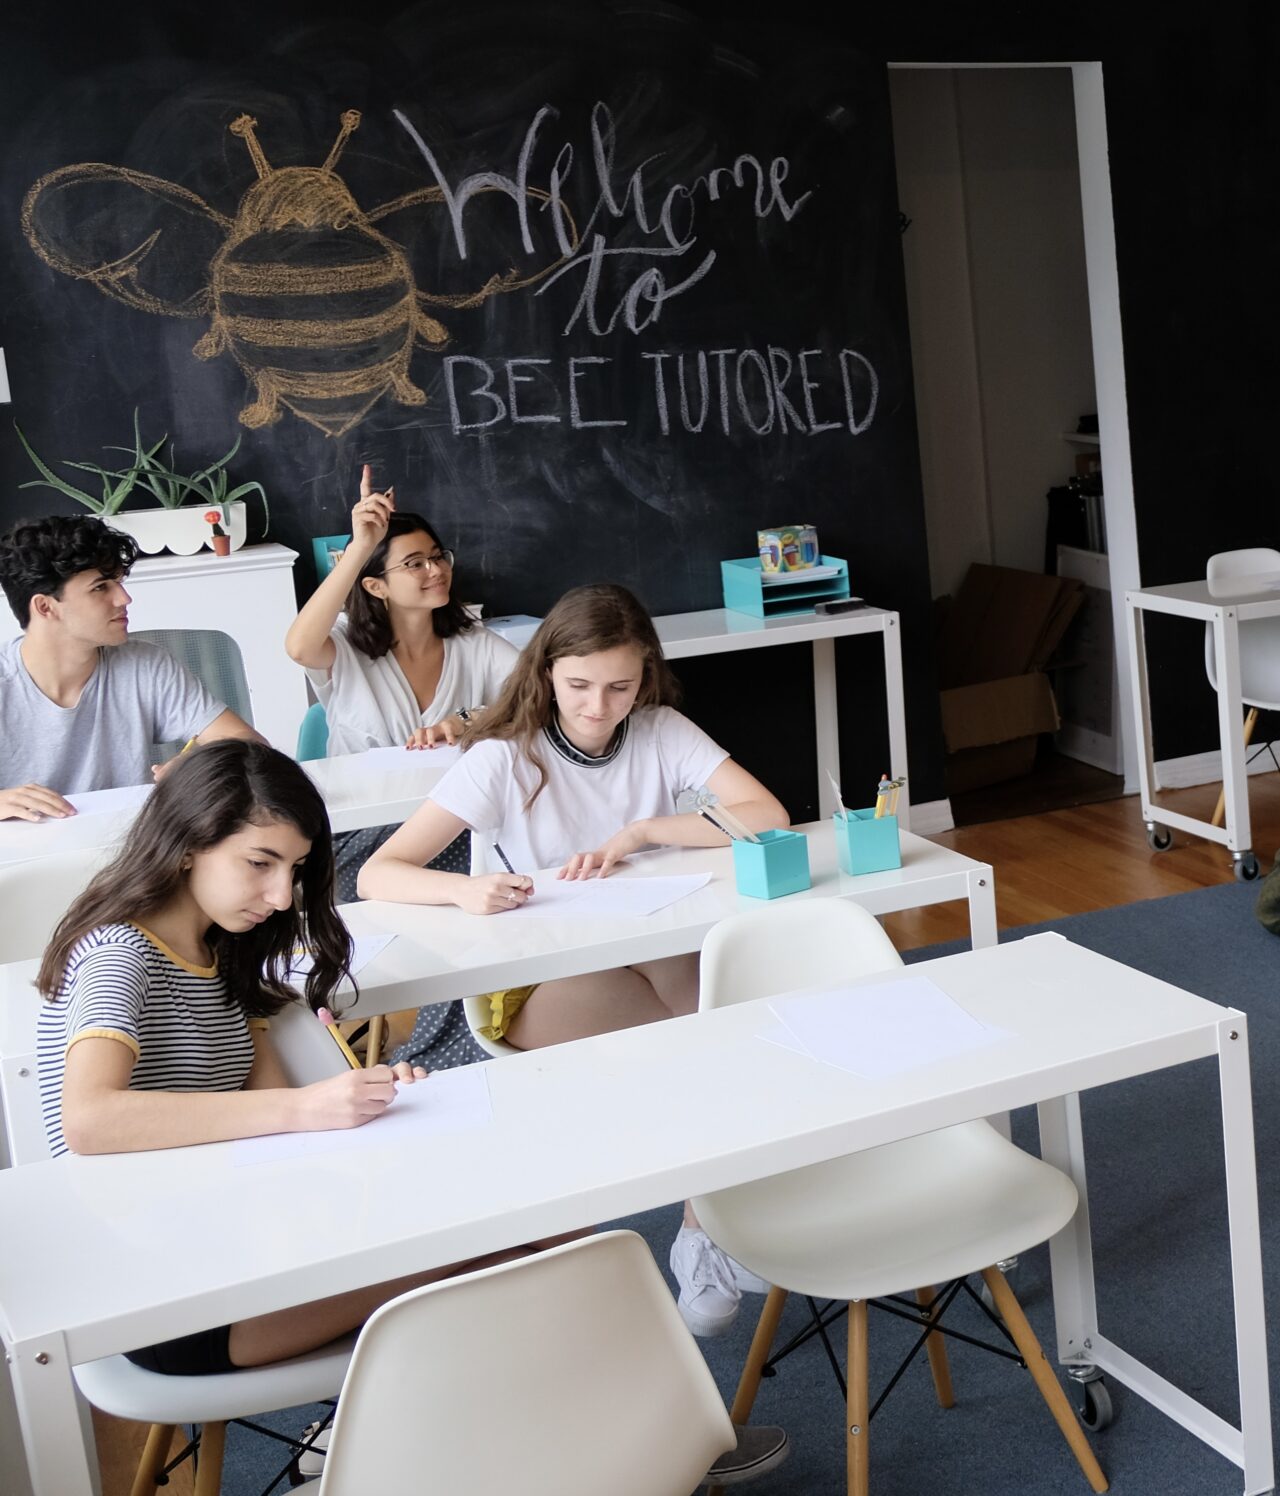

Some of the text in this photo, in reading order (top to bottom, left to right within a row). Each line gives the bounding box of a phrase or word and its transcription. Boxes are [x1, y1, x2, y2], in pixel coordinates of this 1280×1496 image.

[393, 101, 814, 259] Welcome
[535, 233, 717, 337] to
[443, 344, 879, 436] BEE TUTORED
